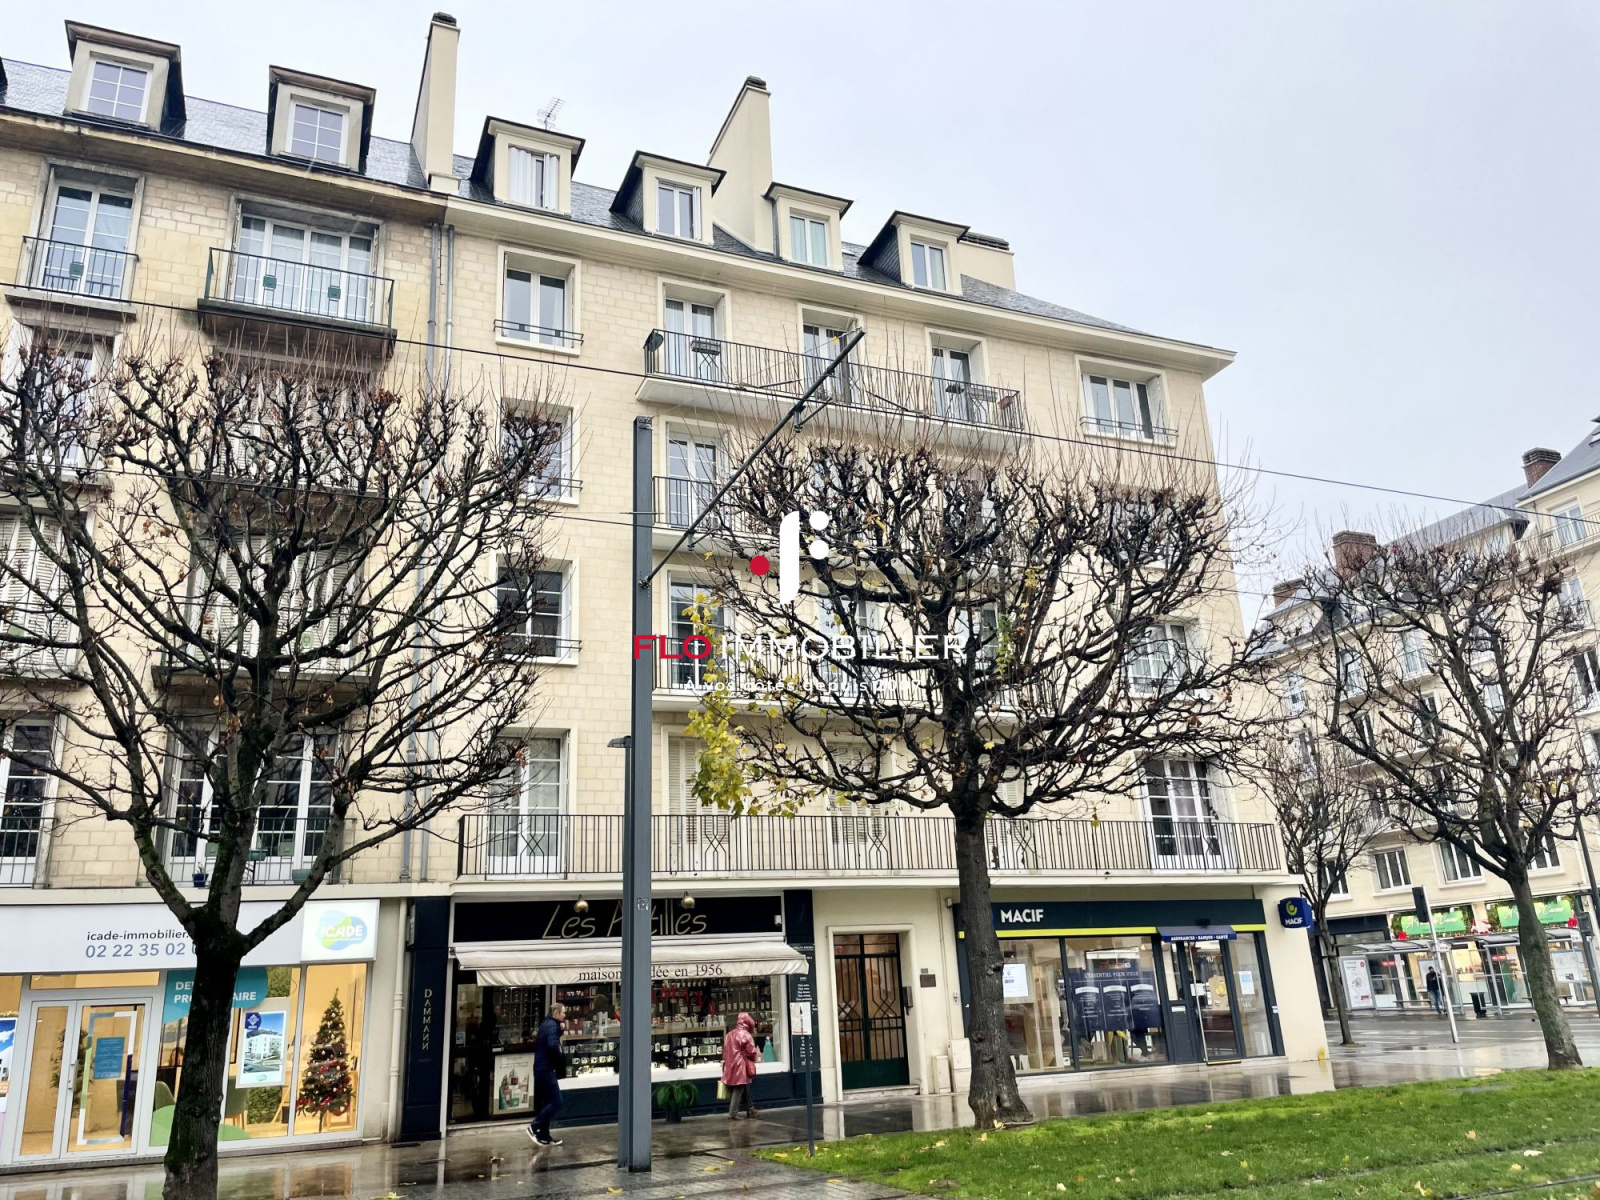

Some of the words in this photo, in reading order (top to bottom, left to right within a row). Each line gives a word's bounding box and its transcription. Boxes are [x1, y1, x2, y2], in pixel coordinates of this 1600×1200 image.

[541, 904, 596, 939] Les
[1000, 908, 1044, 923] MACIF
[1284, 916, 1303, 926] MACIF
[320, 924, 364, 938] ICADE
[85, 944, 107, 958] 02
[112, 943, 134, 957] 22
[138, 942, 160, 956] 35
[165, 942, 186, 956] 02
[578, 968, 623, 981] maison
[674, 967, 689, 977] en
[695, 963, 723, 977] 1956
[421, 988, 433, 1051] DAMMANN
